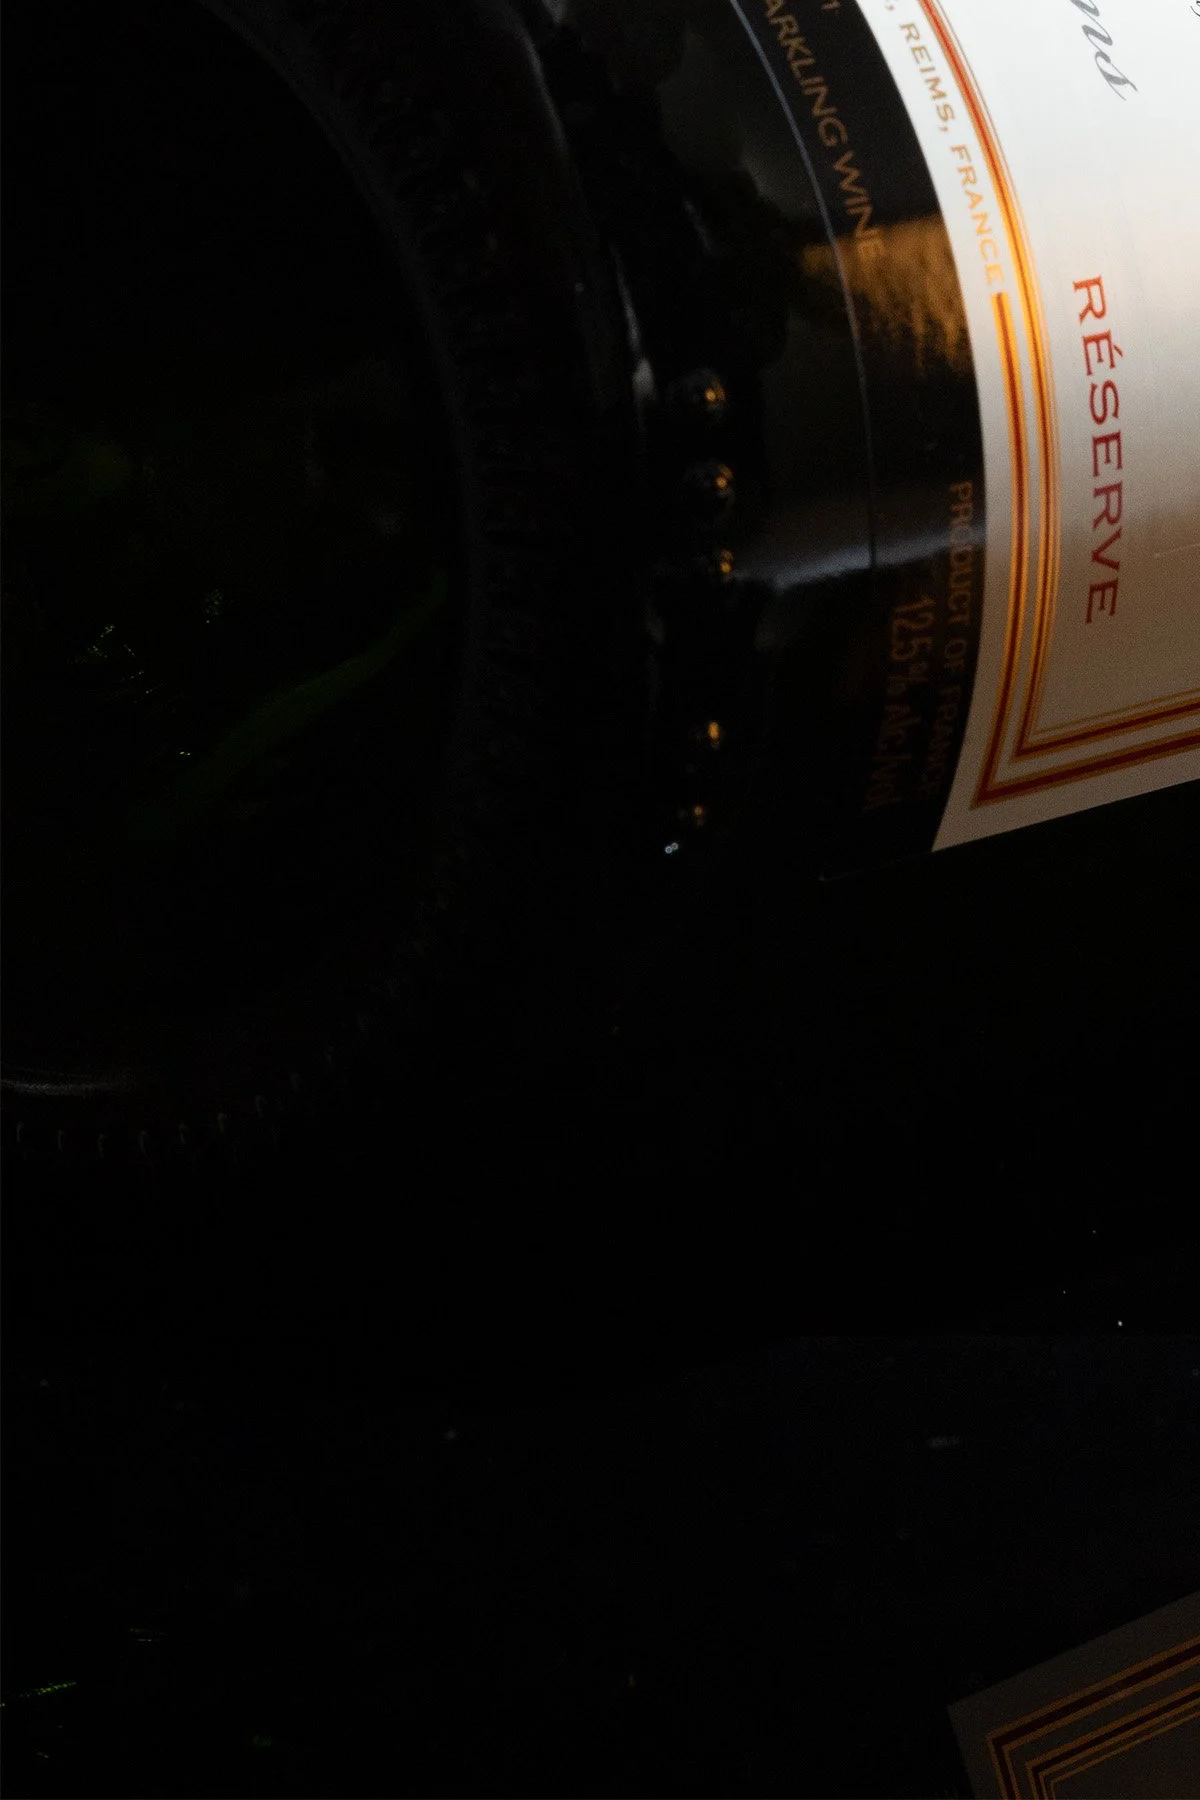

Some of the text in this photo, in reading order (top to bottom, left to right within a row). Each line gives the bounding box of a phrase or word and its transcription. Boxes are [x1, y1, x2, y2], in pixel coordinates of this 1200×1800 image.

[833, 150, 884, 260] WINE
[900, 21, 956, 134] REIMS,
[950, 143, 1006, 286] FRANCE
[1072, 275, 1124, 625] RÉSERVE
[945, 479, 974, 628] PRODUCT
[943, 637, 969, 677] OF
